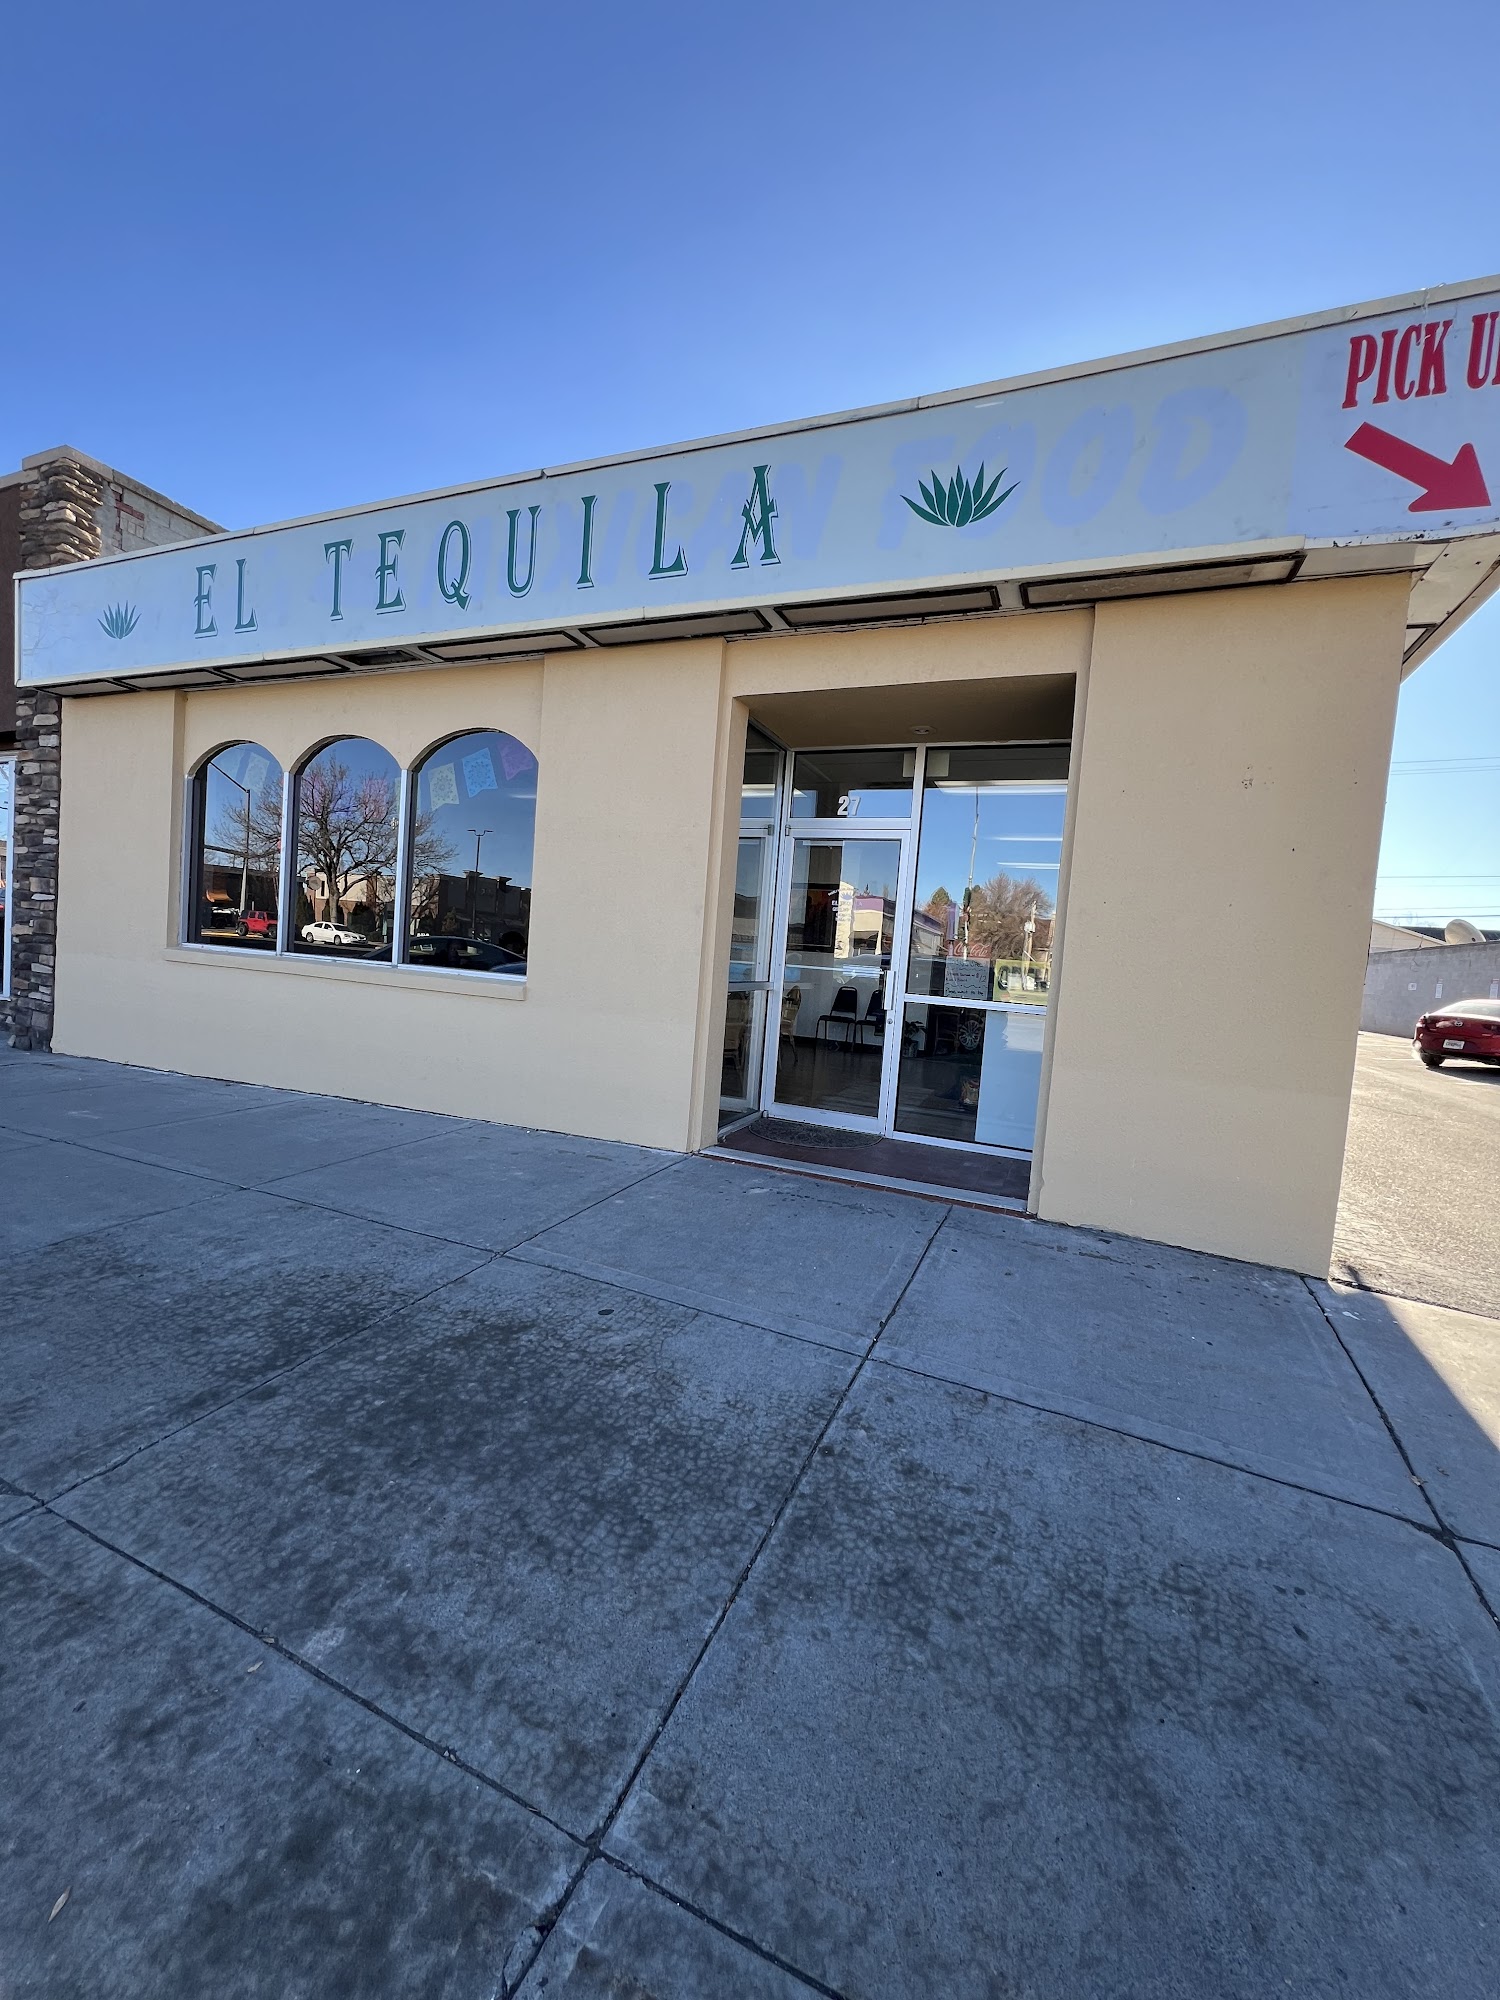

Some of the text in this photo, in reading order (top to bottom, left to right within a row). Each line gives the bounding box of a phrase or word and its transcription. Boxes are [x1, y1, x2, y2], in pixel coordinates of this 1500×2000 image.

[1342, 311, 1500, 409] PICK U
[194, 465, 781, 639] EL TEQUILA
[837, 795, 861, 816] 27
